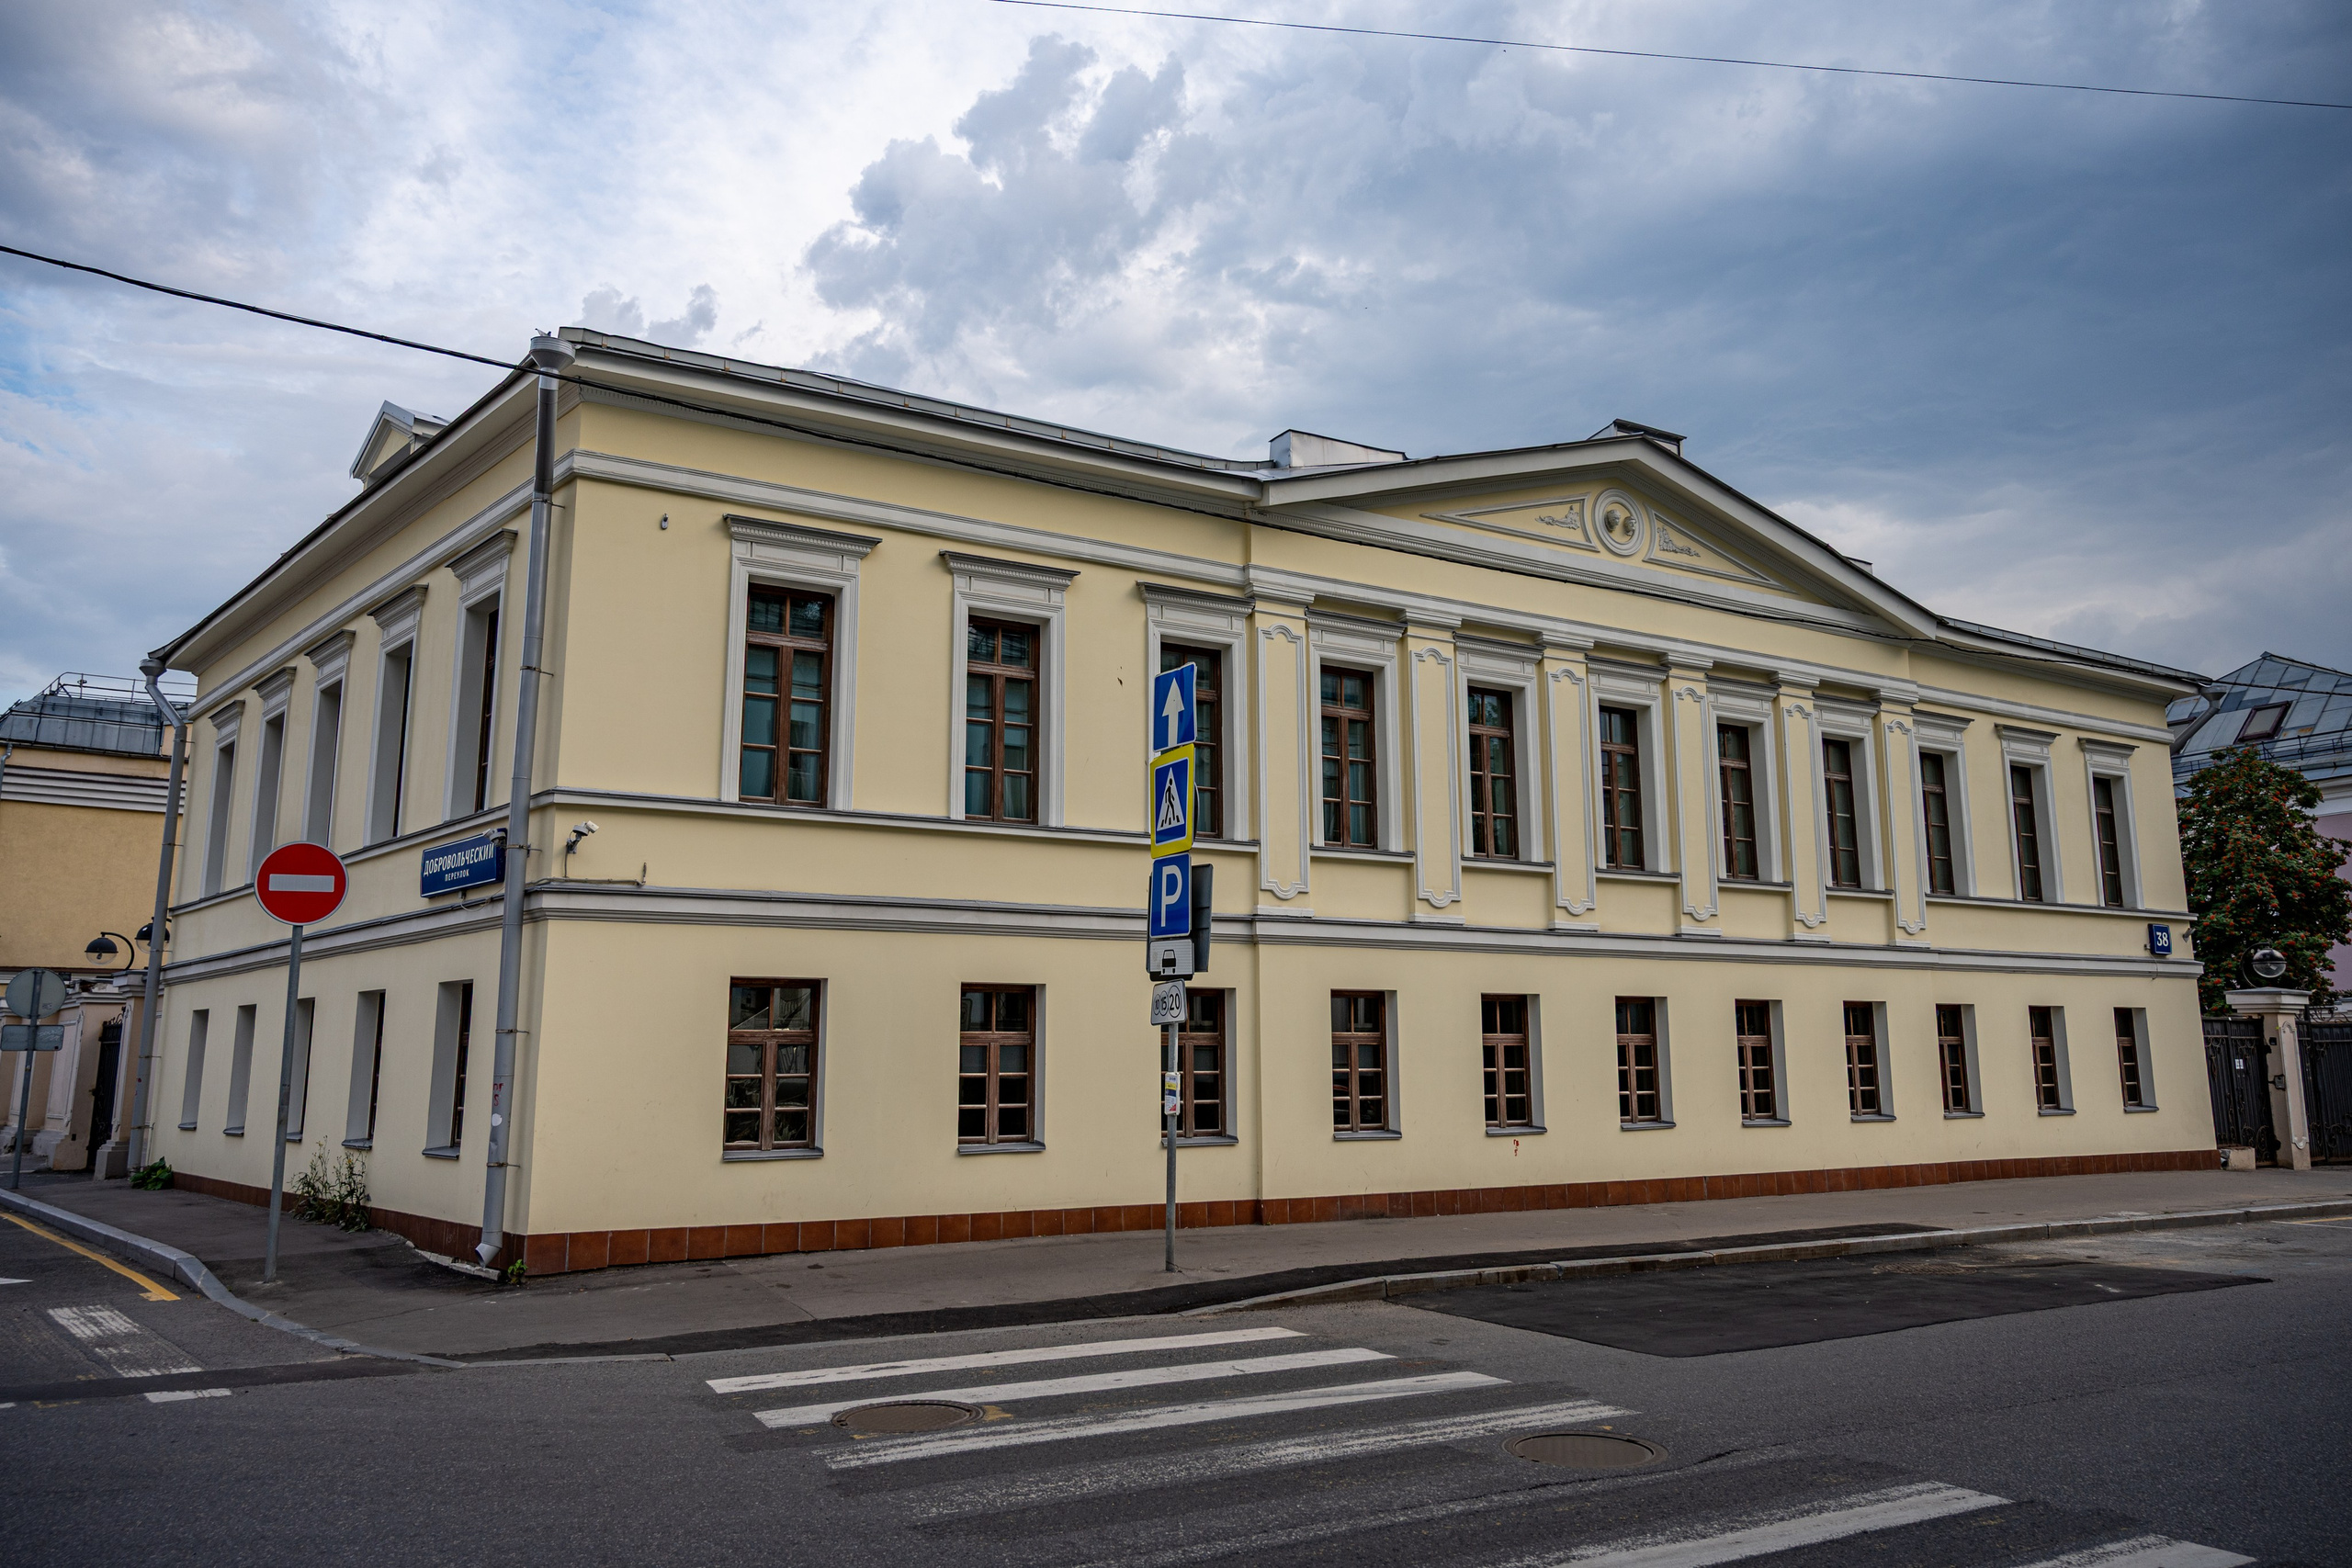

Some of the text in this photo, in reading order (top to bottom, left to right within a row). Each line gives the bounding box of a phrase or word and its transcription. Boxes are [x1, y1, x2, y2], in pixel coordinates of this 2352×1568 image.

[445, 869, 469, 882] ПЕРЕУЛОК
[1160, 864, 1182, 928] P
[2156, 931, 2169, 947] 38
[1160, 996, 1167, 1011] 15
[1169, 993, 1181, 1010] 20
